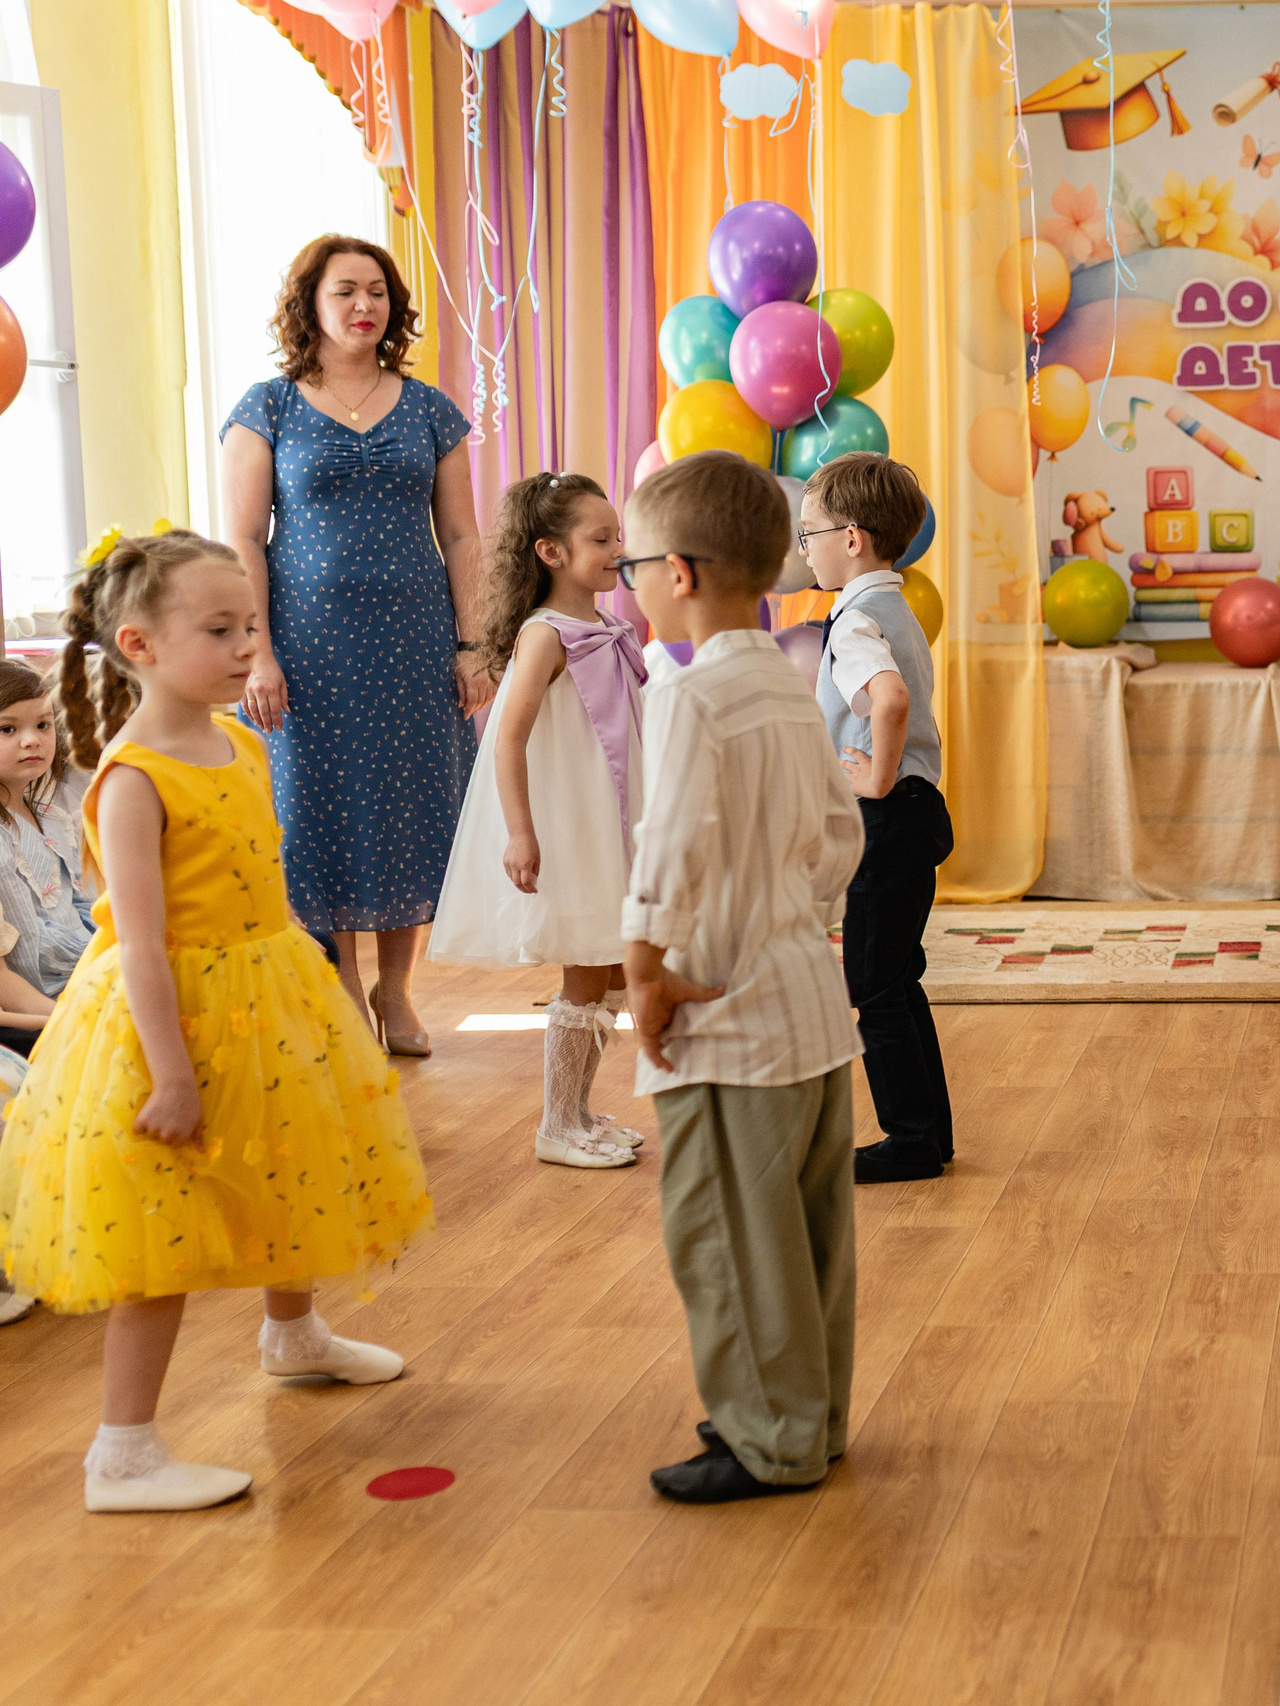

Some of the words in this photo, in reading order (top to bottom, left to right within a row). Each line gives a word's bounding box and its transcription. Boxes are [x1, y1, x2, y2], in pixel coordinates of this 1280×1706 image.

[1177, 282, 1267, 323] ДО
[1163, 478, 1182, 501] A
[1166, 519, 1184, 543] B
[1221, 519, 1239, 543] C
